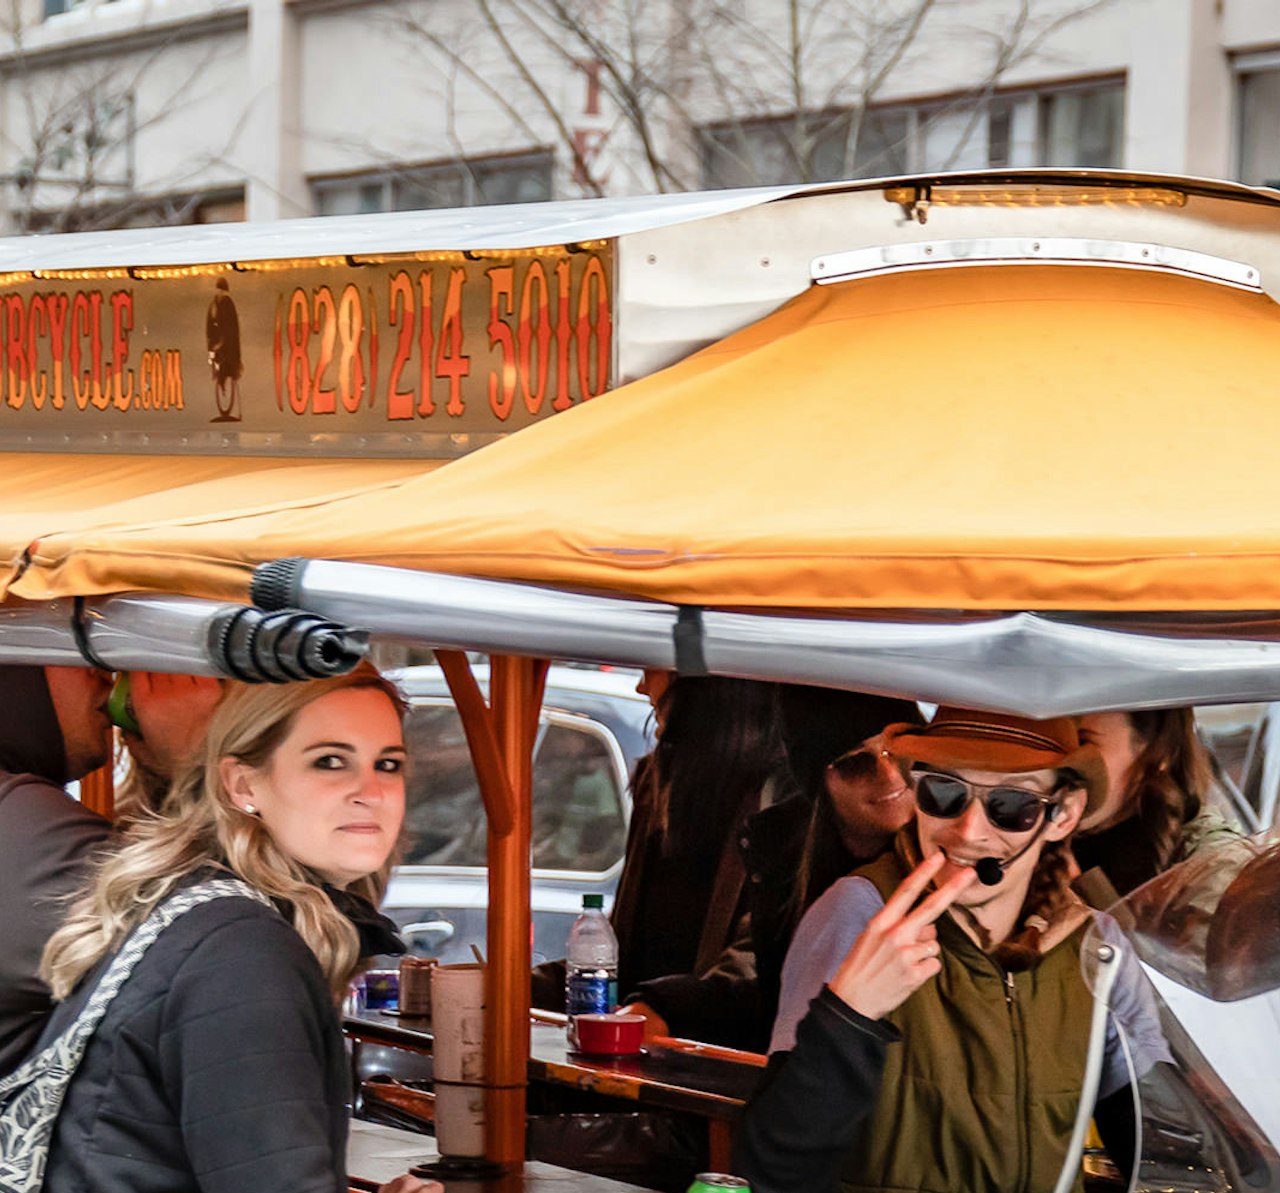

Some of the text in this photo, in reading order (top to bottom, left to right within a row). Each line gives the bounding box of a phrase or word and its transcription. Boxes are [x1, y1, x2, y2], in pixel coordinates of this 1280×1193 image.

[273, 283, 379, 414] (828)
[387, 266, 470, 421] 214
[487, 255, 612, 421] 5010
